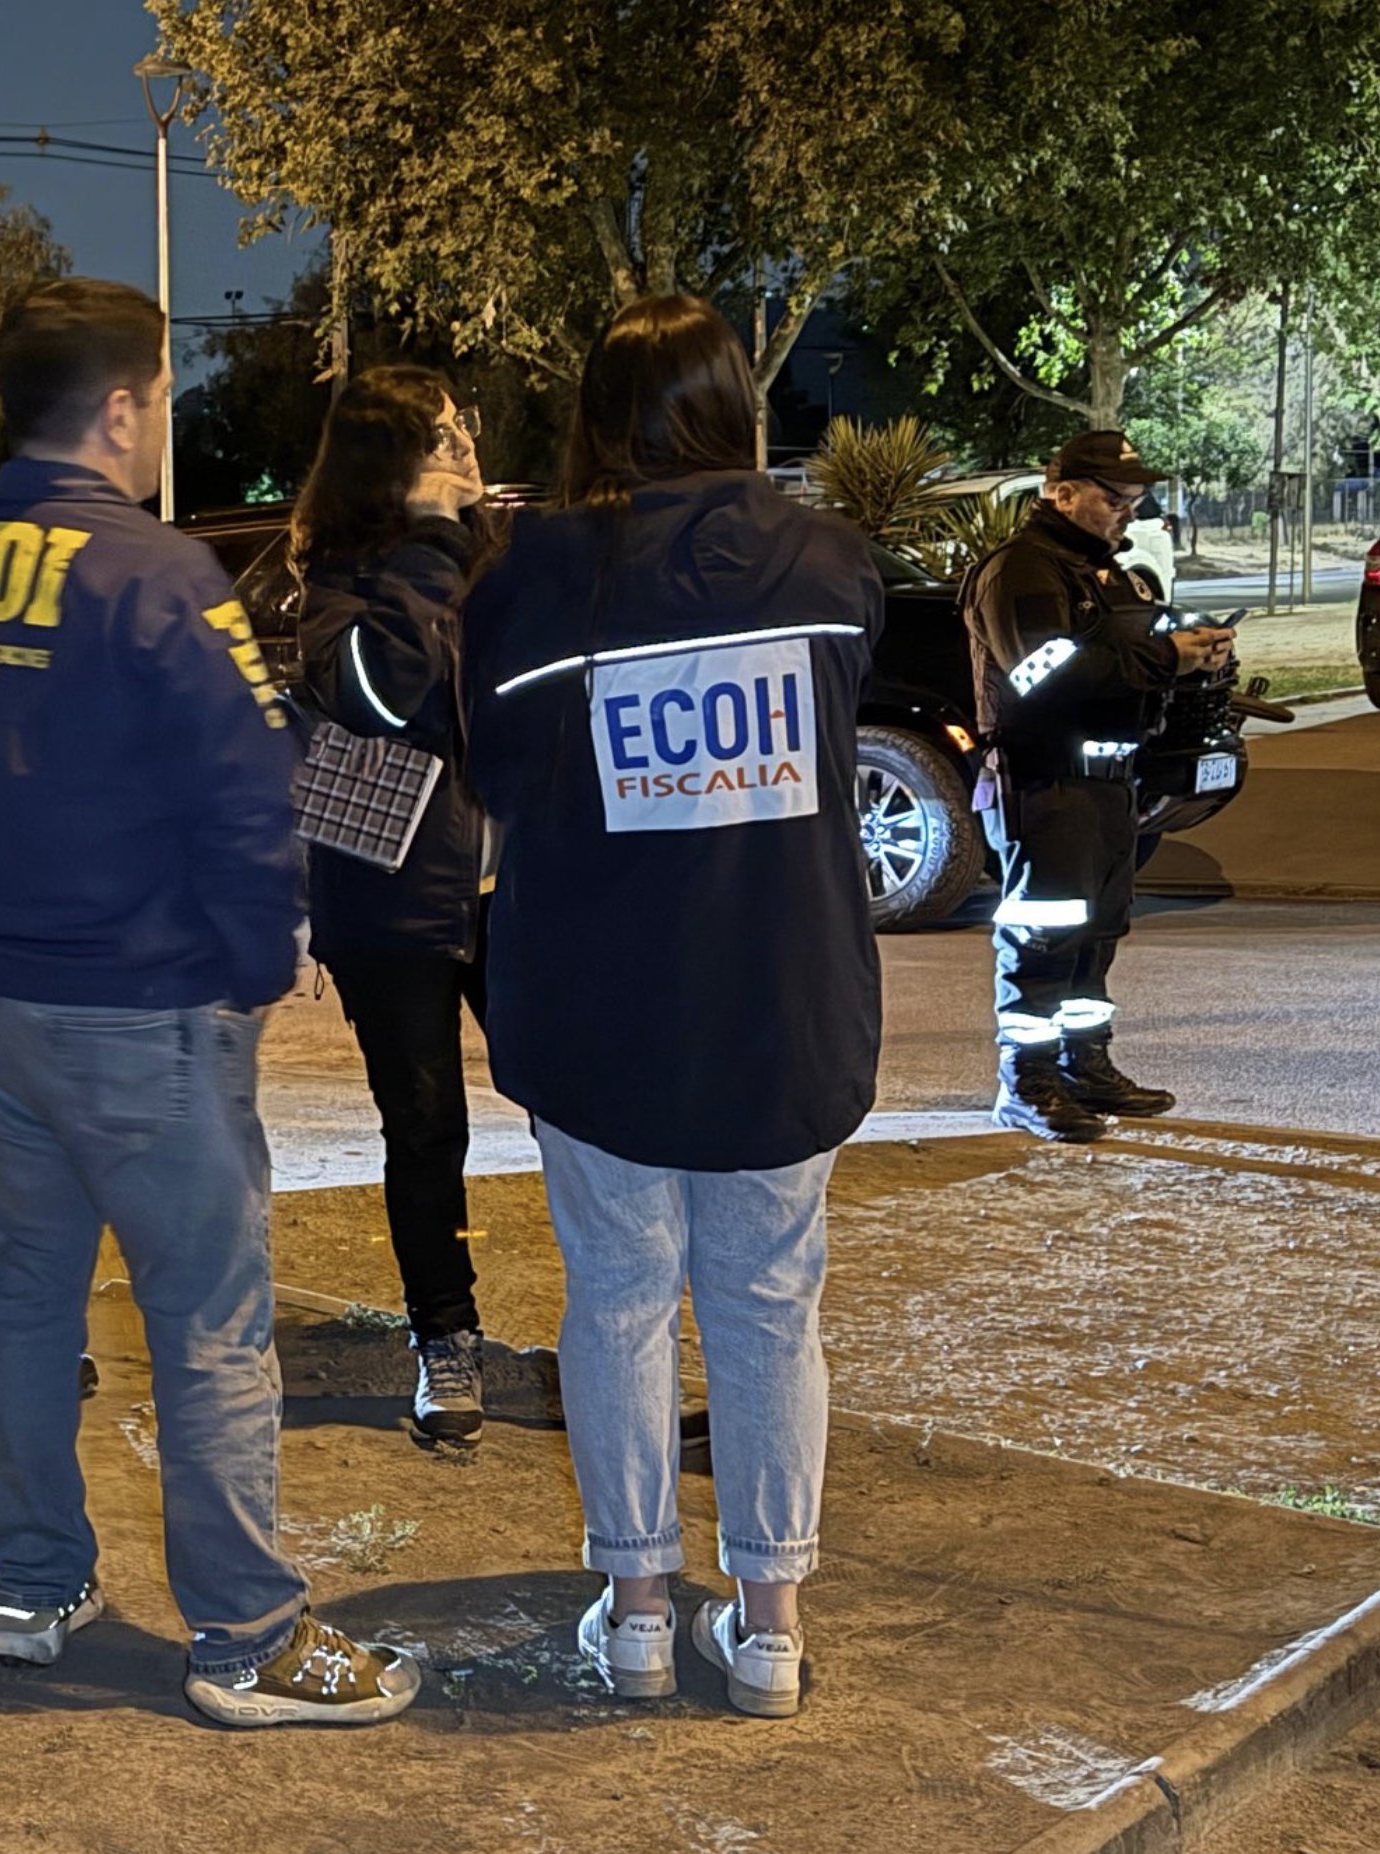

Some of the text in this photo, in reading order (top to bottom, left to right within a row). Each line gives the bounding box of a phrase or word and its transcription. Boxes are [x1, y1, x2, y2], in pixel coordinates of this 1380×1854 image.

[604, 673, 801, 770] ECOH
[616, 761, 802, 799] FISCALIA
[629, 1622, 662, 1633] VEJA
[756, 1640, 790, 1653] VEJA
